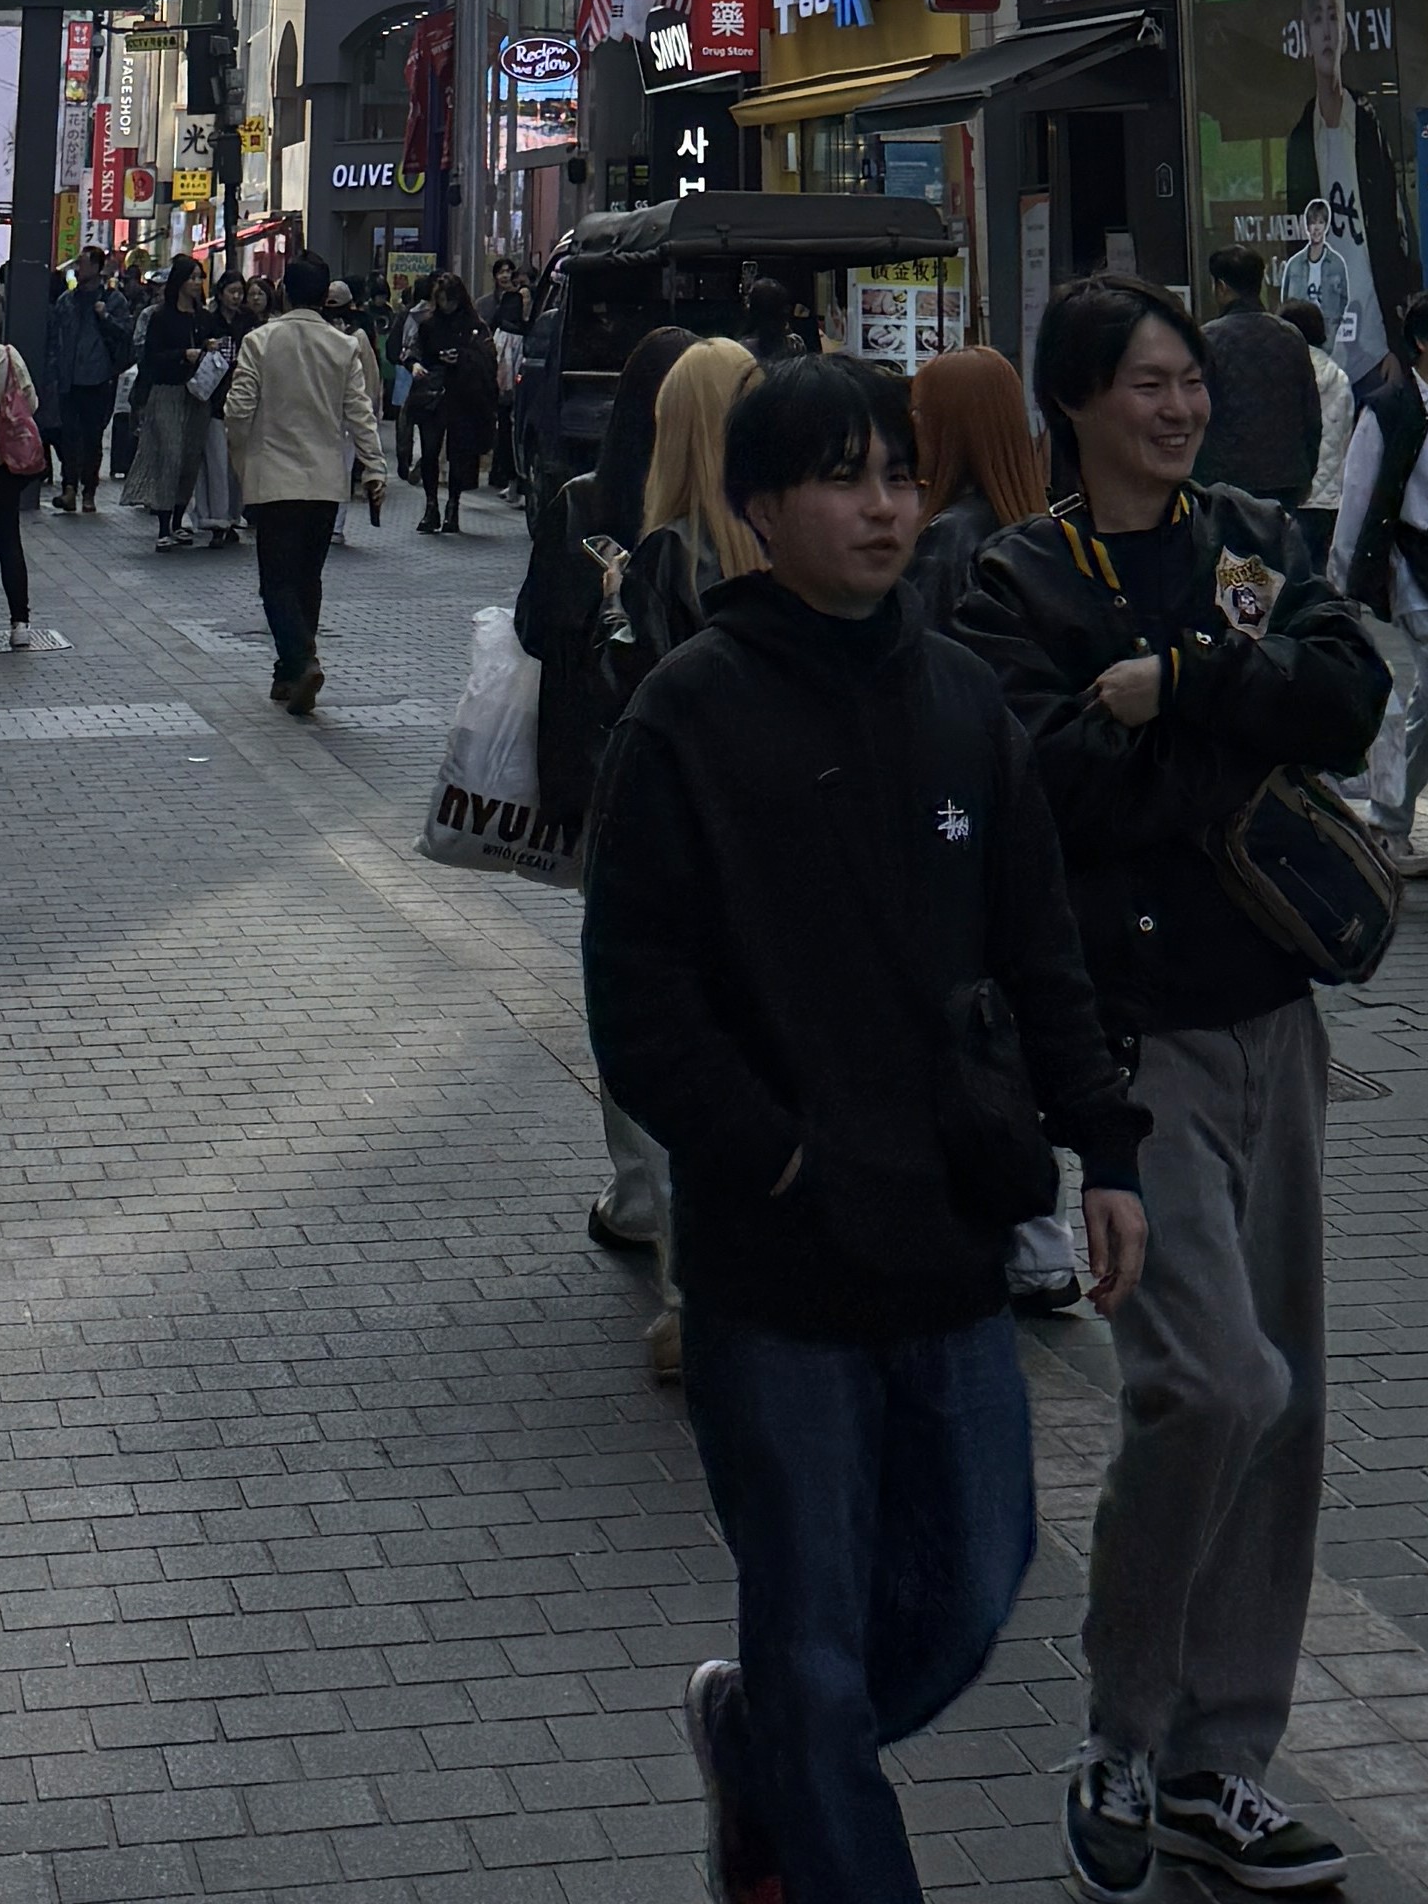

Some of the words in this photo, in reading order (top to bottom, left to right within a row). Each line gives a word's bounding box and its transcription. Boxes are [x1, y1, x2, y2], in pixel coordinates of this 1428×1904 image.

[649, 21, 694, 72] SAVOY
[702, 46, 726, 59] Drug
[727, 45, 754, 57] Store
[119, 94, 133, 136] SHOP
[100, 168, 115, 214] SKIN
[332, 163, 395, 189] OLIVE
[1234, 215, 1264, 242] NCT
